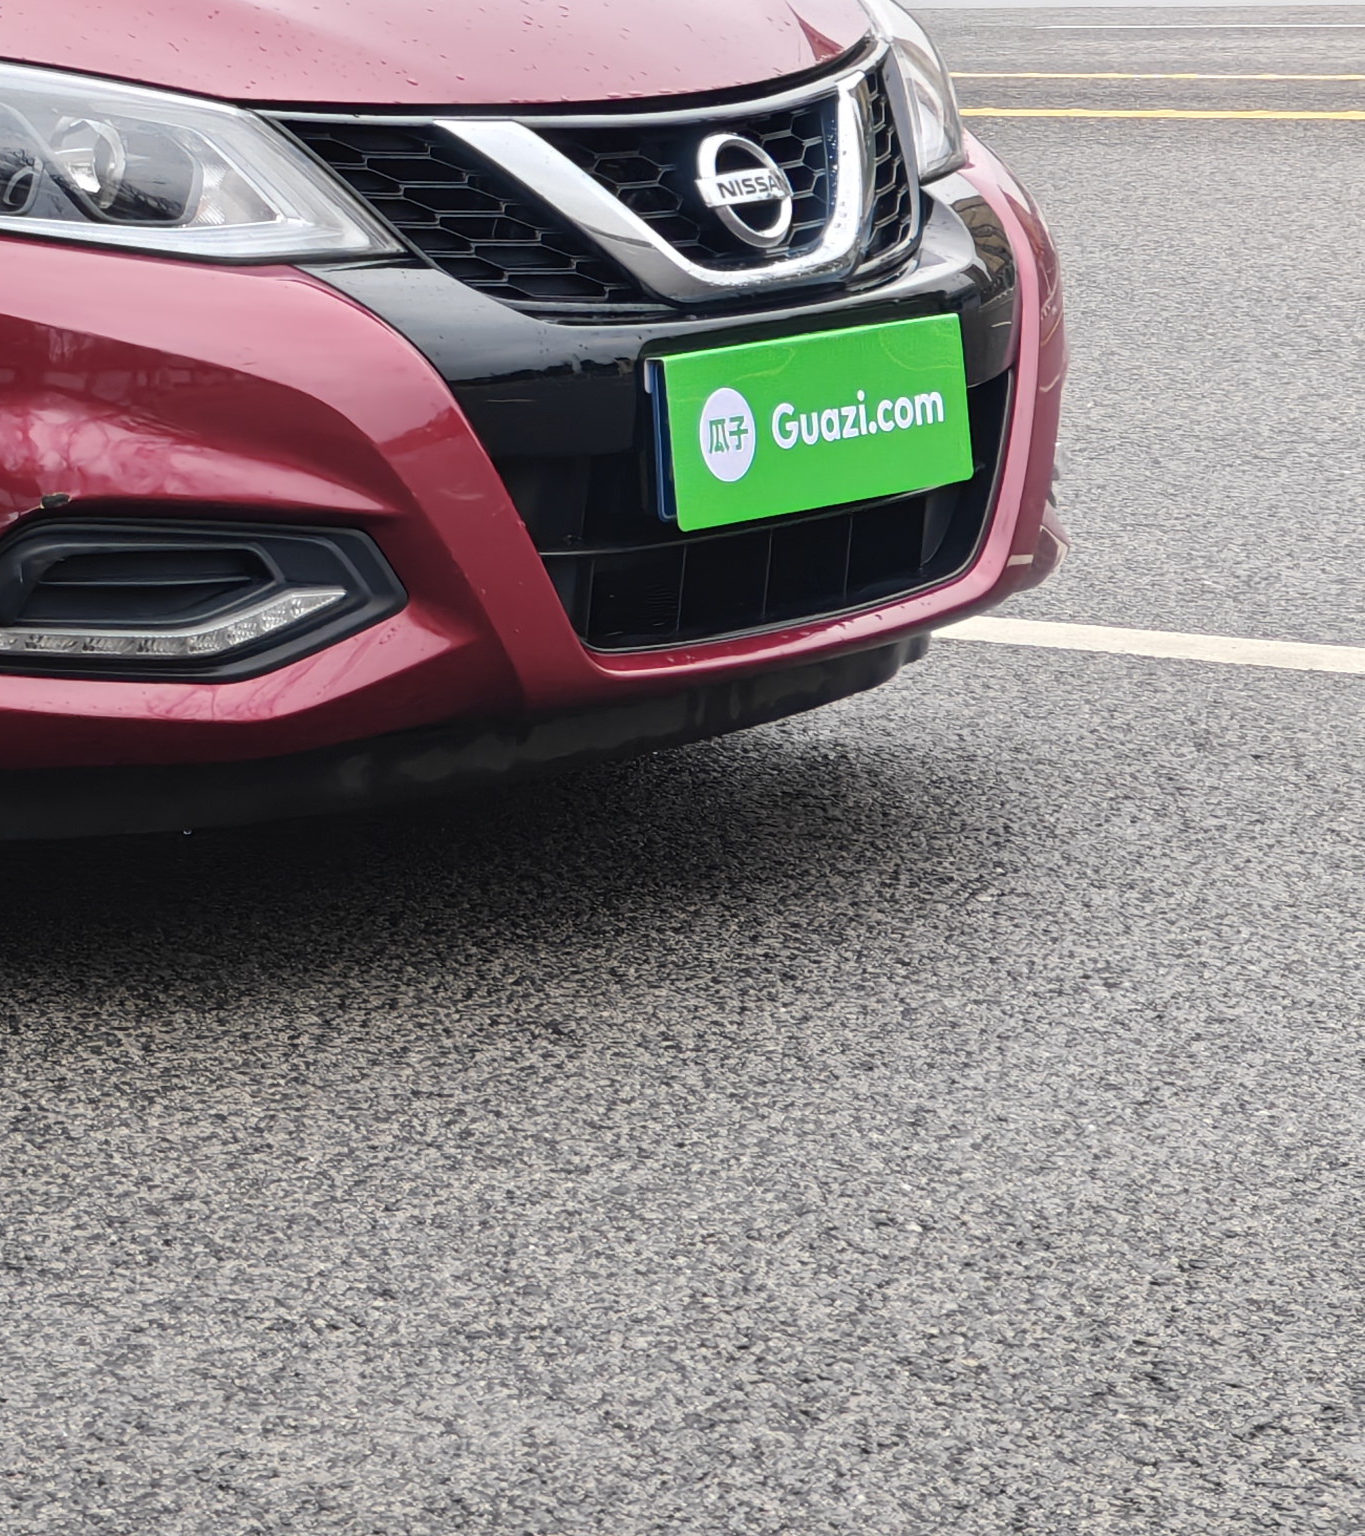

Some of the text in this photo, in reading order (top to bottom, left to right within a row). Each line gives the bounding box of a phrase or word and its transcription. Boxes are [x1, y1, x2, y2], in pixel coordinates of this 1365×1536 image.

[716, 172, 789, 199] NISSAN
[709, 415, 748, 454] 瓜子
[772, 390, 944, 450] Guazi.com
